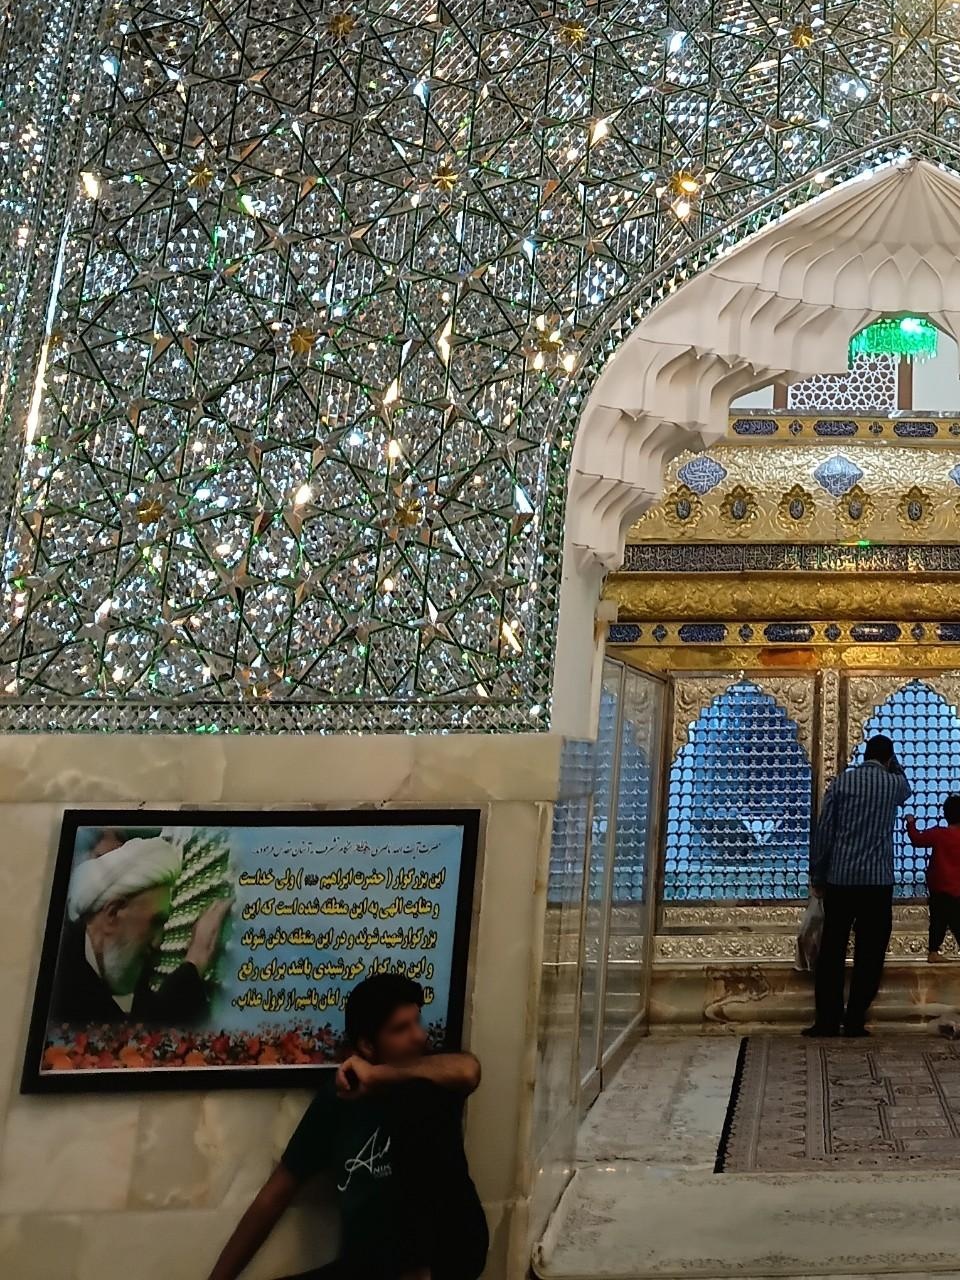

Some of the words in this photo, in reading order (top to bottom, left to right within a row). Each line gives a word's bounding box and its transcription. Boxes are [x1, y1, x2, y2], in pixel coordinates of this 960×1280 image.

[238, 866, 276, 886] خداست
[275, 867, 296, 890] ولی
[319, 867, 354, 890] ابراهیم
[392, 866, 429, 889] بزرگوار
[428, 866, 446, 889] این
[241, 897, 261, 920] این
[260, 897, 276, 915] که
[274, 896, 298, 916] است
[297, 897, 320, 916] شده
[319, 896, 350, 916] منطقه
[349, 896, 368, 920] این
[368, 900, 379, 918] به
[377, 895, 404, 919] الهی
[402, 896, 432, 919] عنایت
[432, 902, 440, 918] و
[240, 928, 266, 951] شوند
[265, 926, 288, 950] دفن
[287, 927, 316, 946] منطقه
[314, 927, 334, 950] این
[333, 930, 348, 950] در
[347, 933, 355, 949] و
[355, 927, 380, 950] شوند
[379, 930, 403, 949] شهید
[400, 926, 437, 949] بزرگوار
[237, 956, 260, 981] رفع
[259, 957, 288, 981] برای
[287, 956, 314, 979] باشد
[312, 956, 366, 981] خورشیدی
[405, 955, 427, 979] این
[425, 962, 434, 979] و
[262, 987, 286, 1011] نزول
[285, 987, 297, 1011] از
[295, 987, 320, 1011] باشیم
[318, 987, 340, 1011] امان
